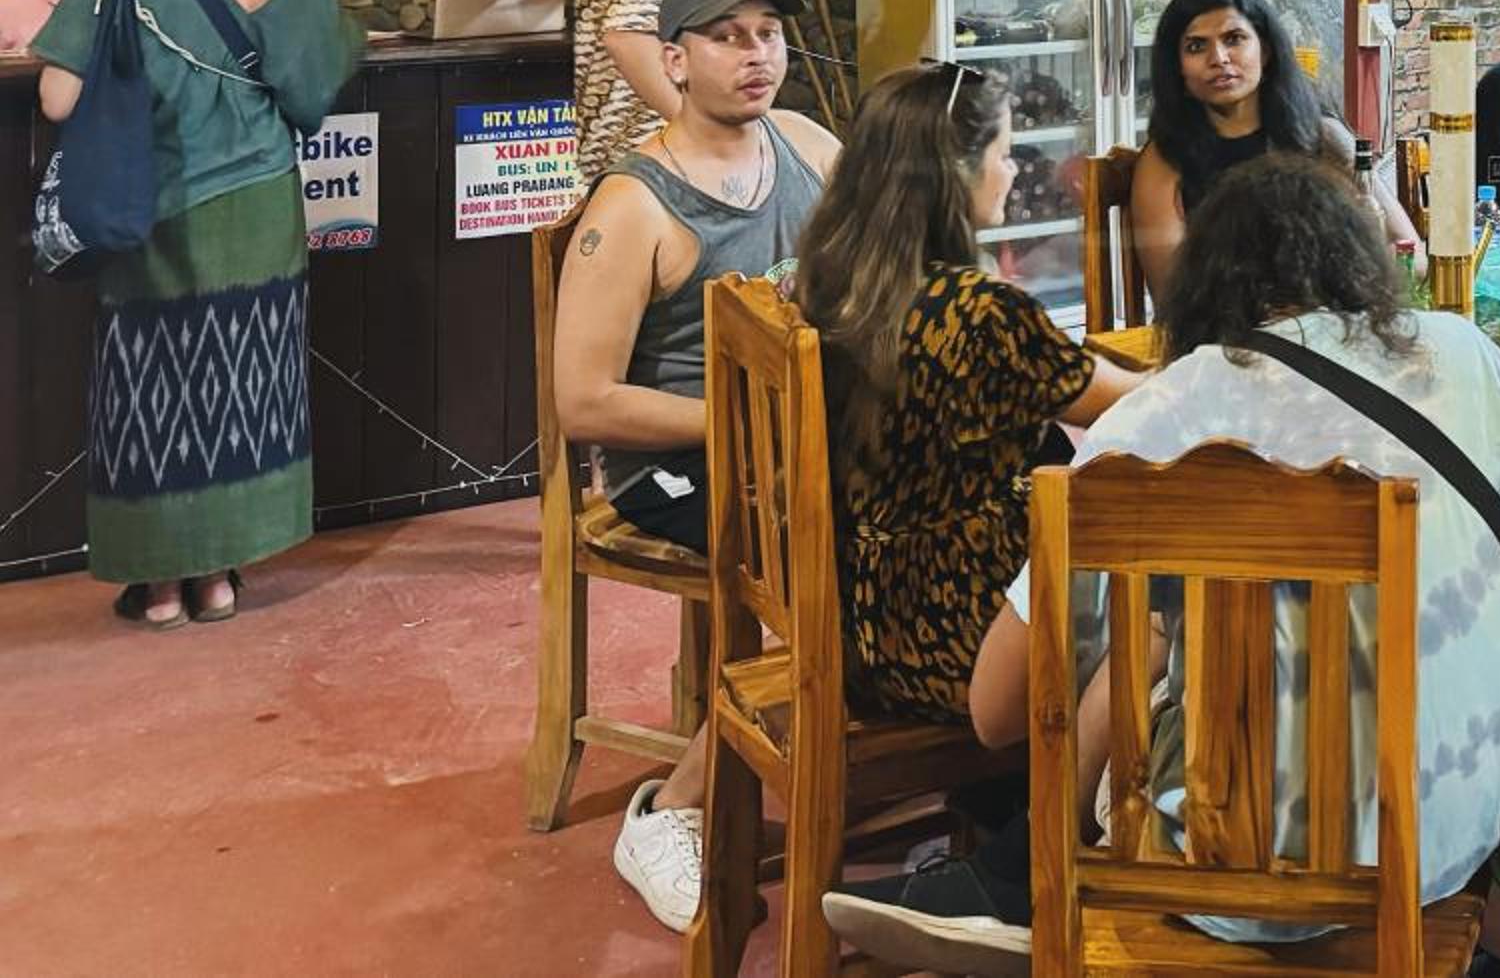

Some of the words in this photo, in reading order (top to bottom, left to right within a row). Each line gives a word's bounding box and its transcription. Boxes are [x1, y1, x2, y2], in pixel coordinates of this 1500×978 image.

[483, 110, 512, 128] HTX
[517, 105, 549, 128] VẬN
[296, 131, 373, 160] bike
[497, 163, 531, 177] BUS:
[466, 182, 509, 198] LUANG
[513, 176, 575, 194] PRABANG
[461, 201, 491, 215] BOOK
[494, 198, 517, 211] BUS
[521, 193, 565, 210] TICKETS
[459, 213, 525, 231] DESTINATION
